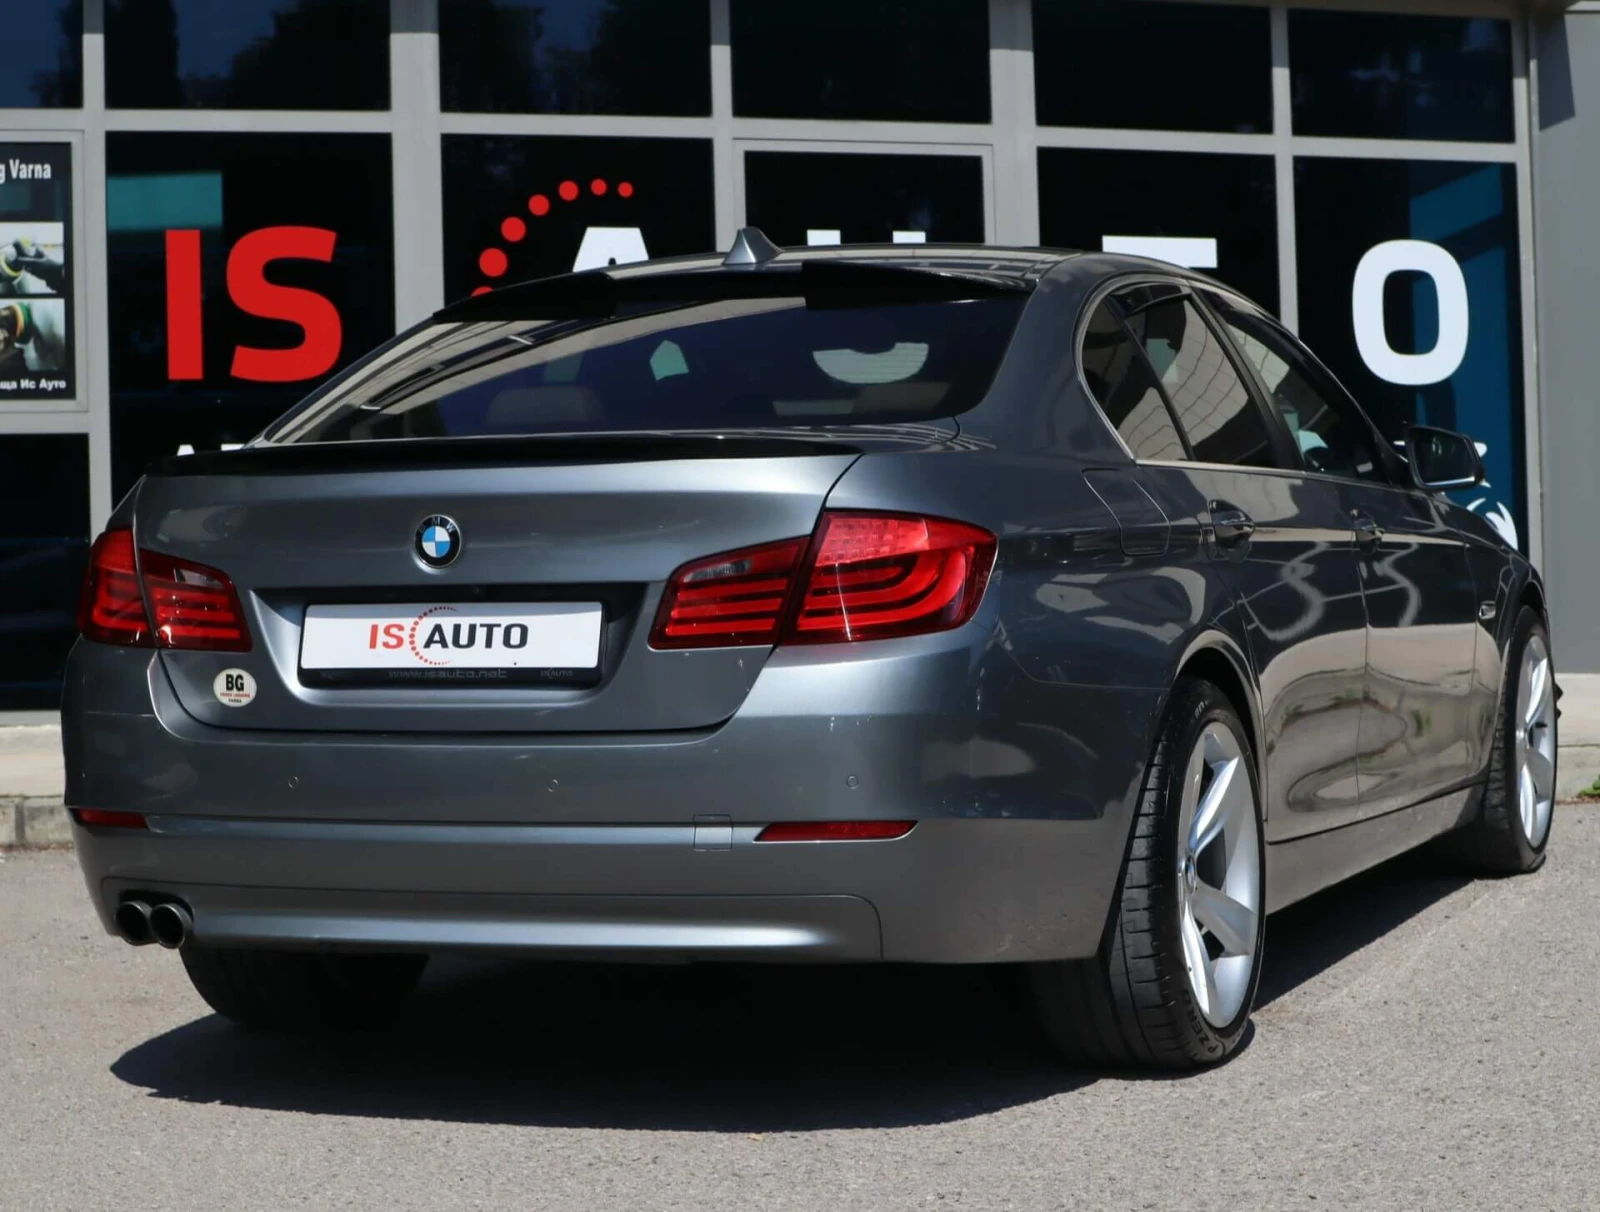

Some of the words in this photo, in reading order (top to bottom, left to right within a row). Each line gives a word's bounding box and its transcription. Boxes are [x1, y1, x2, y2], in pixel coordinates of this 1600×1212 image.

[9, 159, 52, 179] Varna
[165, 225, 342, 382] IS
[20, 378, 36, 389] Ис
[39, 378, 67, 391] Ауто
[368, 623, 405, 650] IS
[423, 623, 529, 650] AUTO
[225, 673, 245, 692] BG
